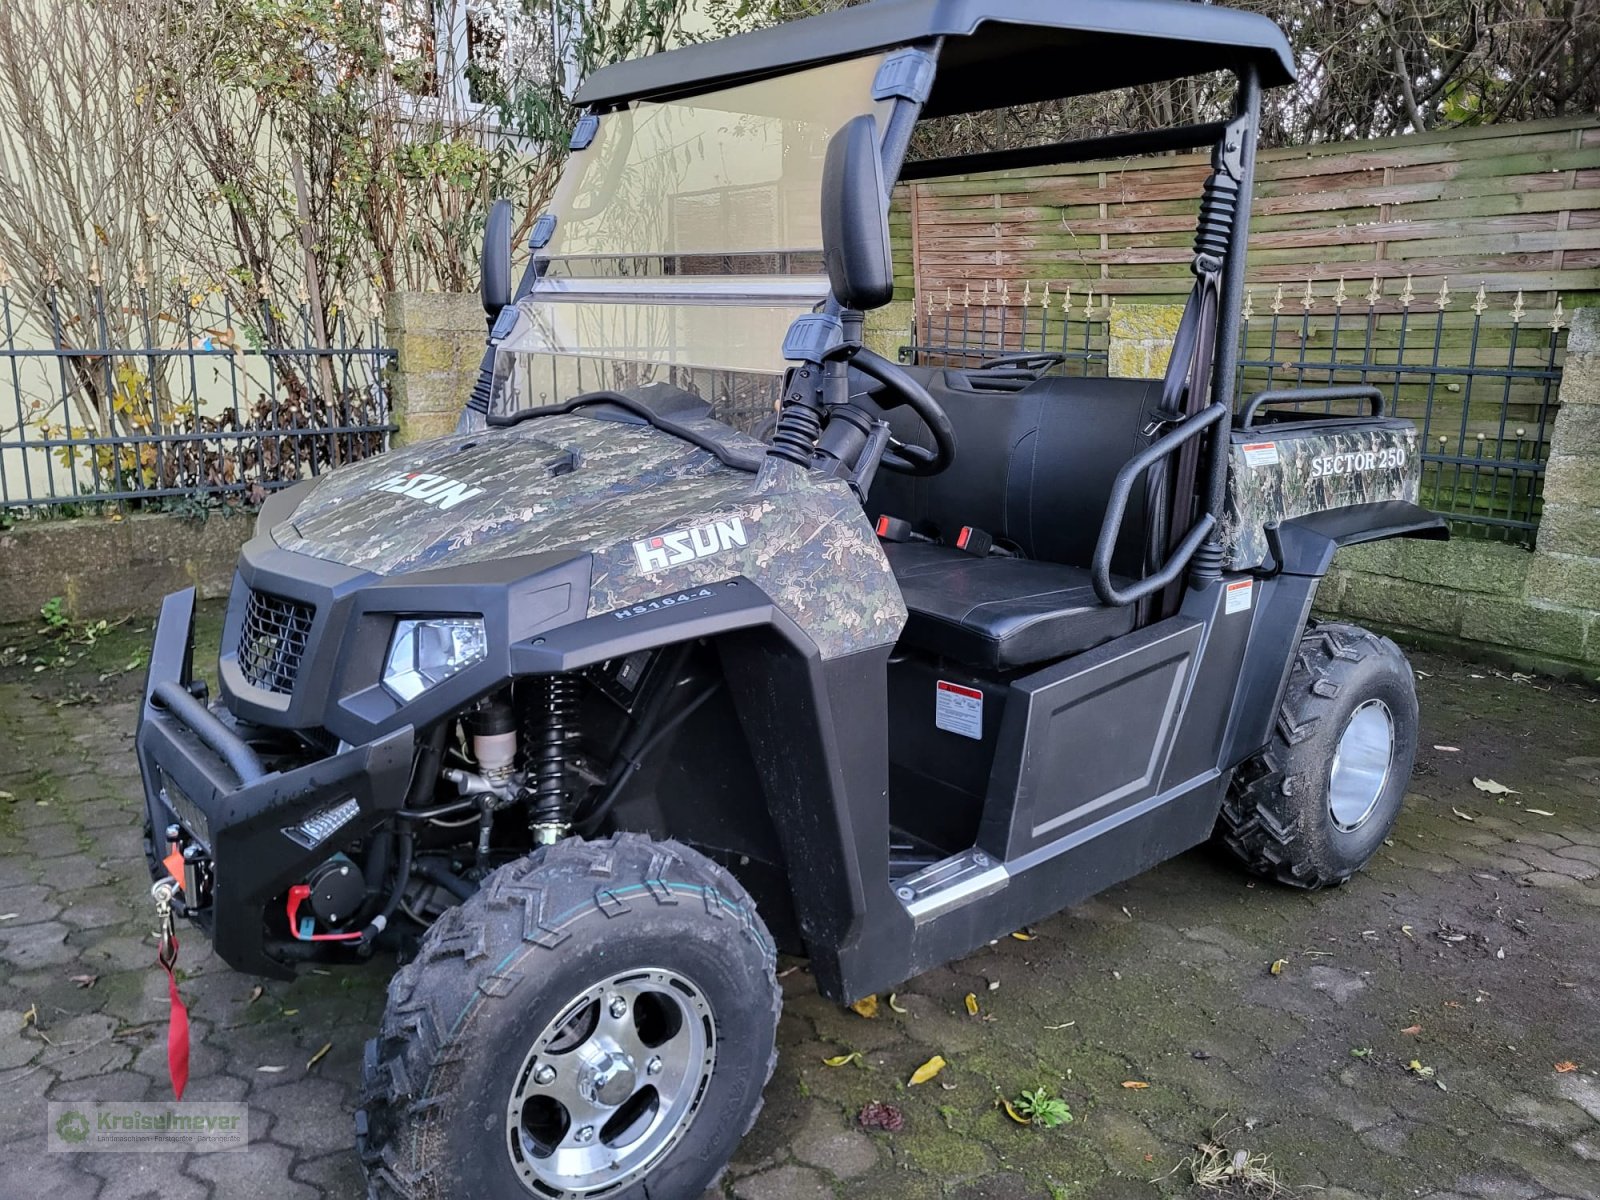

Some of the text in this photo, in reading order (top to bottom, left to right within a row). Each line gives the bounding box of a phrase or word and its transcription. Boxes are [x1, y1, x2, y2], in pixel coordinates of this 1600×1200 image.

[1312, 448, 1405, 477] SECTOR 250
[368, 472, 484, 510] HSUN
[634, 516, 748, 574] HSUN
[615, 589, 711, 619] HS164-4
